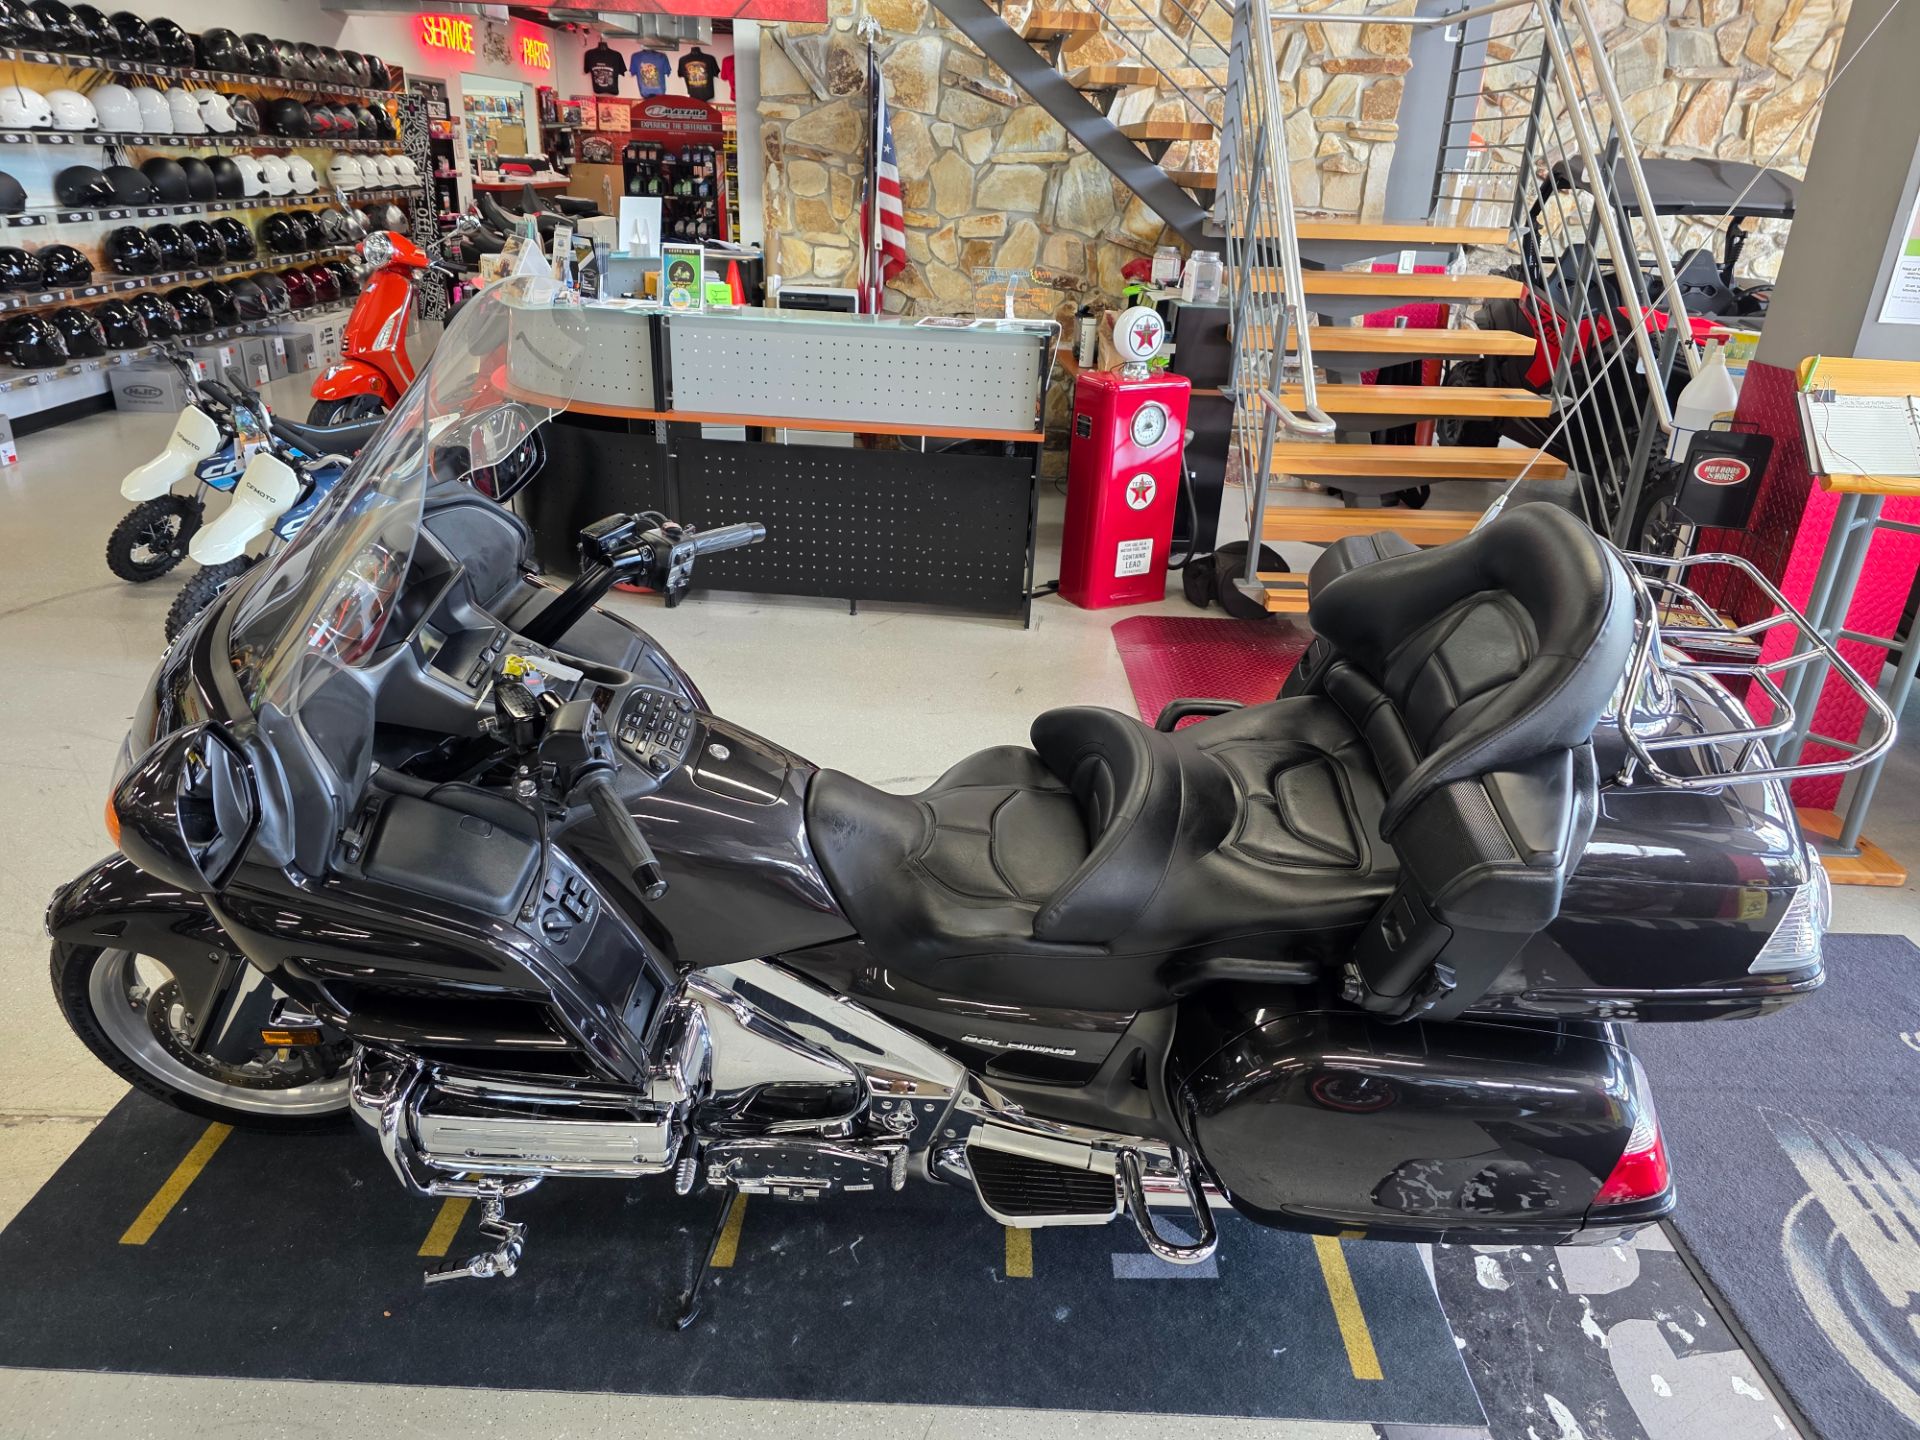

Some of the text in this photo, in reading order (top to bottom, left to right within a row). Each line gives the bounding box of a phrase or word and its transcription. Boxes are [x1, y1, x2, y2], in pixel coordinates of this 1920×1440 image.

[422, 16, 475, 55] SERVICE
[523, 37, 550, 70] PARTS
[640, 120, 712, 132] EXPERIENCE THE DIFFERENCE
[129, 388, 158, 396] HJC
[176, 431, 201, 451] CFMOTO
[1704, 465, 1741, 475] HOT RODS
[1714, 472, 1735, 481] HOGS
[245, 481, 277, 504] CFMOTO
[1122, 552, 1146, 561] CONTAINS
[1125, 560, 1141, 569] LEAD
[72, 996, 167, 1096] MARATHON ULTRA
